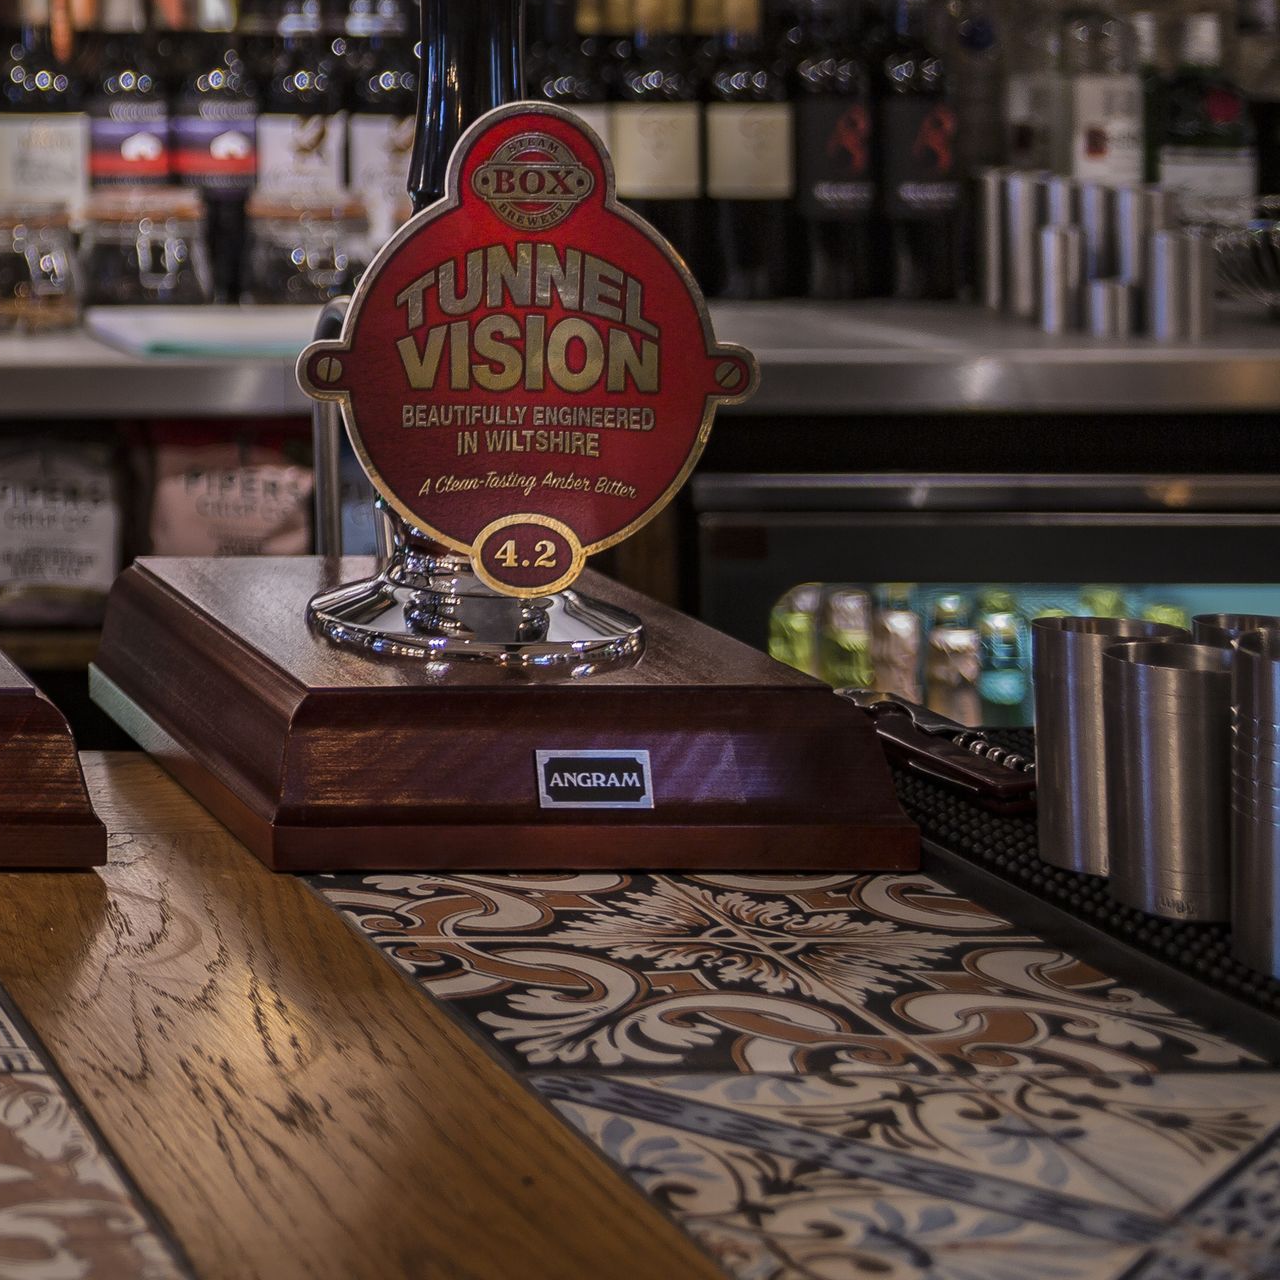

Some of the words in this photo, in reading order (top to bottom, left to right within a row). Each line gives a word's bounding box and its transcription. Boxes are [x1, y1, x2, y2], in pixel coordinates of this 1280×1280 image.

[507, 137, 560, 154] STEAM
[493, 169, 575, 195] BOX
[498, 202, 566, 226] BREWERY
[396, 242, 660, 339] TUNNEL
[395, 314, 660, 393] VISION
[402, 405, 527, 428] BEAUTIFULLY
[533, 405, 656, 431] ENGINEERED
[456, 431, 478, 456] IN
[485, 430, 600, 457] WILTSHIRE
[418, 478, 430, 497] A
[435, 471, 537, 497] Clean-Tasting
[541, 471, 591, 492] Amber
[594, 477, 637, 499] Bitter
[494, 540, 557, 568] 4.2
[549, 772, 641, 787] ANGRAM
